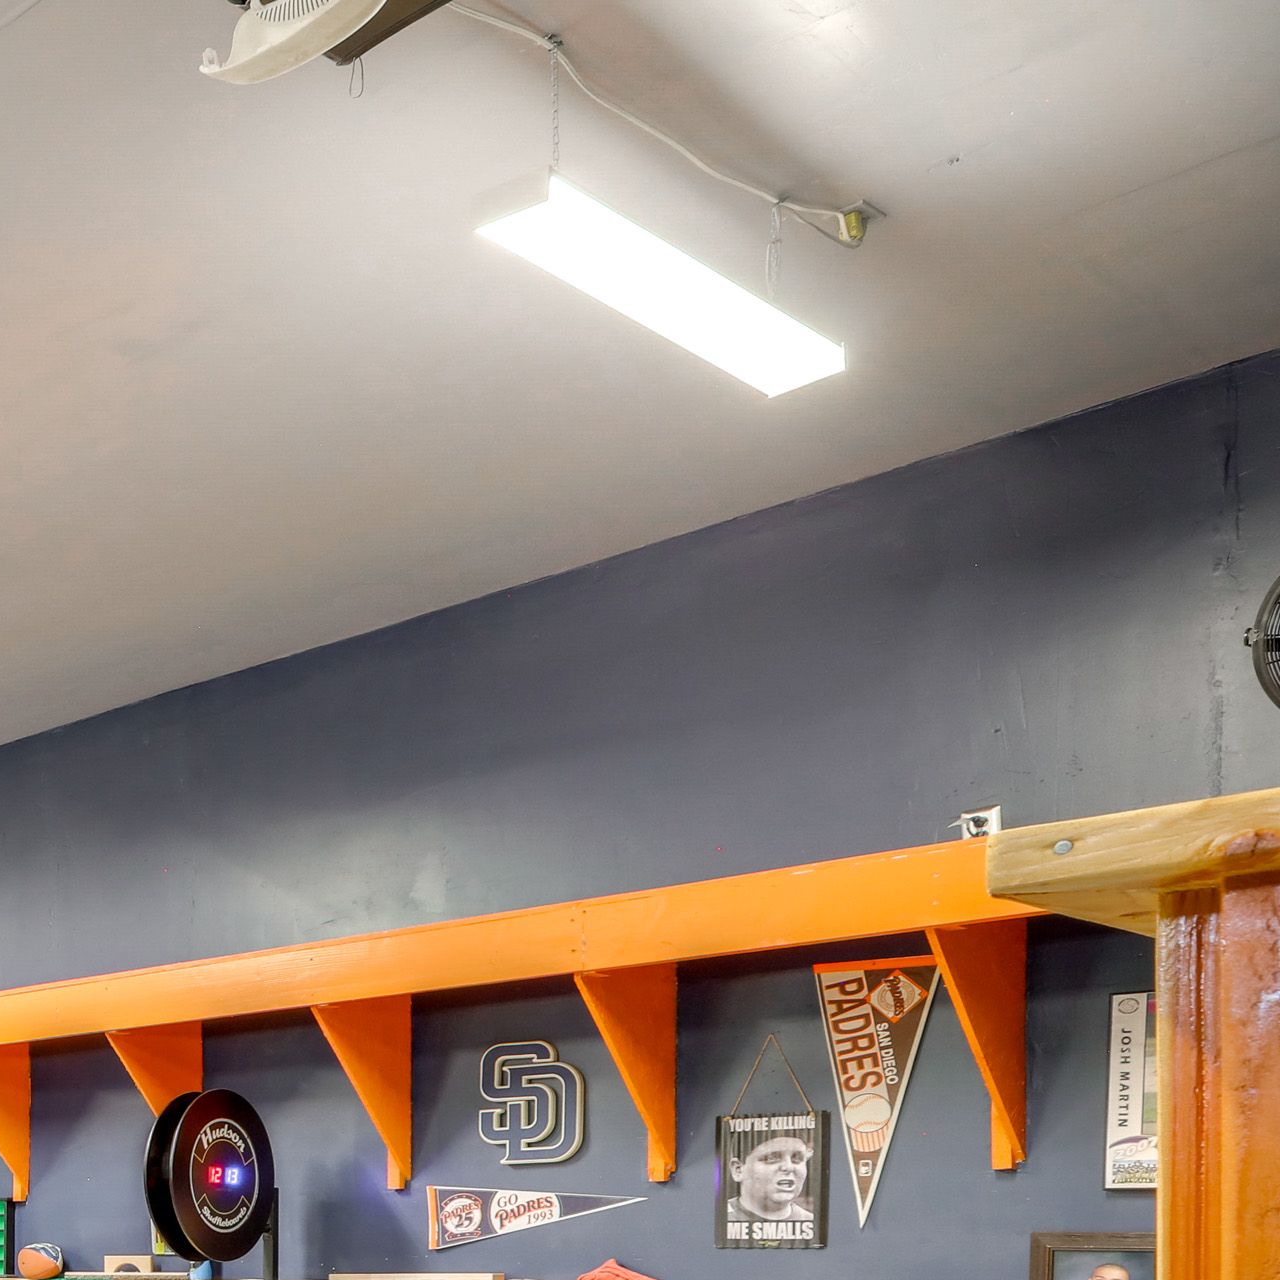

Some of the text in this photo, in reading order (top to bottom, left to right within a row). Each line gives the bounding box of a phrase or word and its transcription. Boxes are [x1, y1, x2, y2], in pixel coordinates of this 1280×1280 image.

[825, 976, 883, 1092] PADRES
[876, 1022, 899, 1085] SAN DIEGO
[1118, 1027, 1132, 1128] JOSH MARTIN
[729, 1115, 816, 1132] YOU'RE KILLING
[201, 1123, 246, 1153] Hudson
[208, 1166, 222, 1184] 12
[225, 1167, 239, 1185] 13
[497, 1193, 518, 1209] GO
[201, 1205, 247, 1228] Shuffleboards
[442, 1201, 482, 1225] PADRES
[454, 1214, 474, 1229] 25
[495, 1196, 556, 1230] PADRES
[527, 1209, 554, 1225] 1993
[727, 1221, 815, 1240] ME SMALLS
